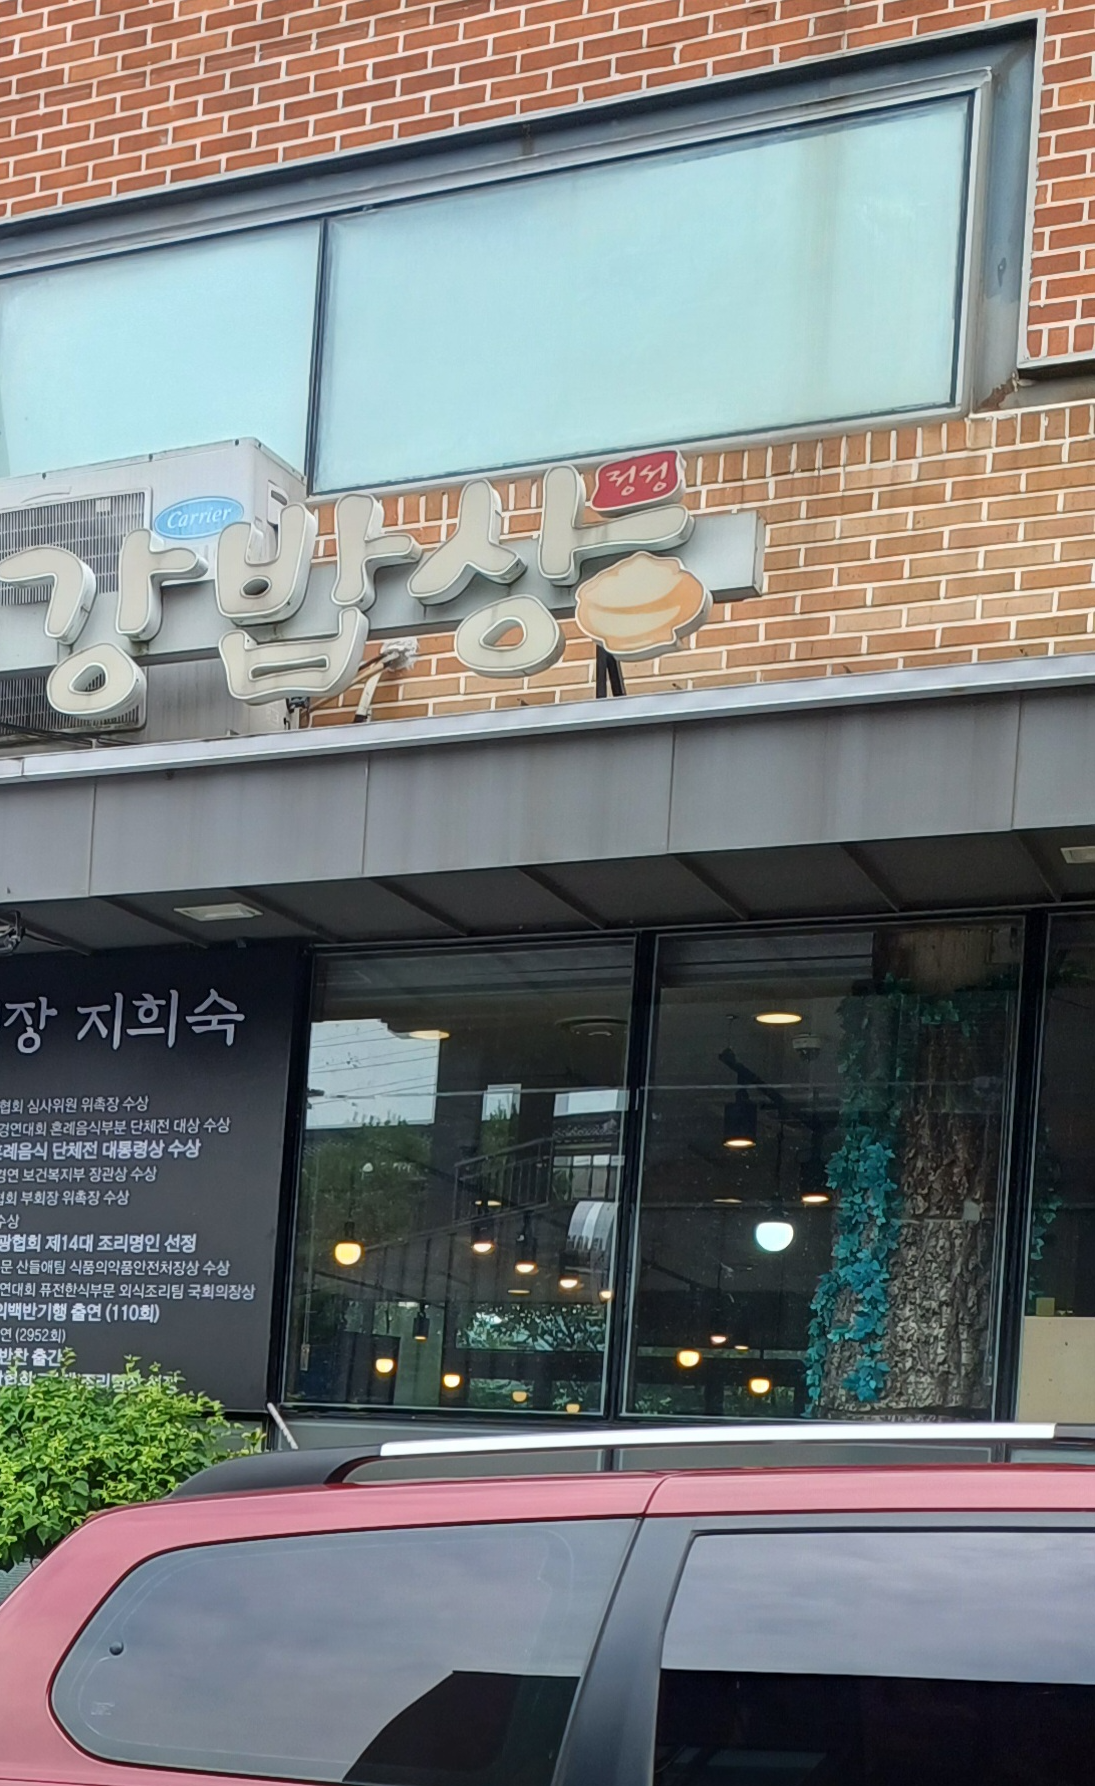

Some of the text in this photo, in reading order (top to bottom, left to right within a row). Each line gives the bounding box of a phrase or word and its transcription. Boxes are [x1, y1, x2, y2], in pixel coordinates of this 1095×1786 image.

[167, 507, 232, 529] Carrier
[76, 988, 245, 1050] 지희숙
[26, 1097, 77, 1114] 심사위원
[80, 1096, 119, 1112] 위촉장
[122, 1095, 149, 1111] 수상
[130, 1119, 169, 1134] 단체전
[173, 1118, 200, 1134] 대상
[202, 1118, 230, 1133] 수상
[52, 1141, 98, 1160] 단체전
[102, 1140, 165, 1159] 대통령상
[167, 1140, 201, 1158] 수상
[21, 1167, 85, 1182] 보건복지부
[89, 1167, 128, 1182] 장관상
[130, 1166, 157, 1182] 수상
[20, 1190, 59, 1206] 부회장
[61, 1190, 100, 1205] 위촉장
[102, 1190, 129, 1205] 수상
[44, 1234, 94, 1252] 제14대
[96, 1234, 160, 1252] 조리명인
[163, 1234, 197, 1253] 선정
[15, 1259, 66, 1274] 산들애팀
[69, 1260, 200, 1276] 식품의약품안전처장상
[202, 1260, 230, 1276] 수상
[38, 1282, 115, 1298] 퓨전한식부문
[118, 1283, 184, 1299] 외식조리팀
[187, 1284, 255, 1300] 국회의장상
[70, 1303, 102, 1321] 출연
[105, 1303, 160, 1323] (110회)
[15, 1327, 66, 1343] (2952회)
[31, 1348, 63, 1366] 출간
